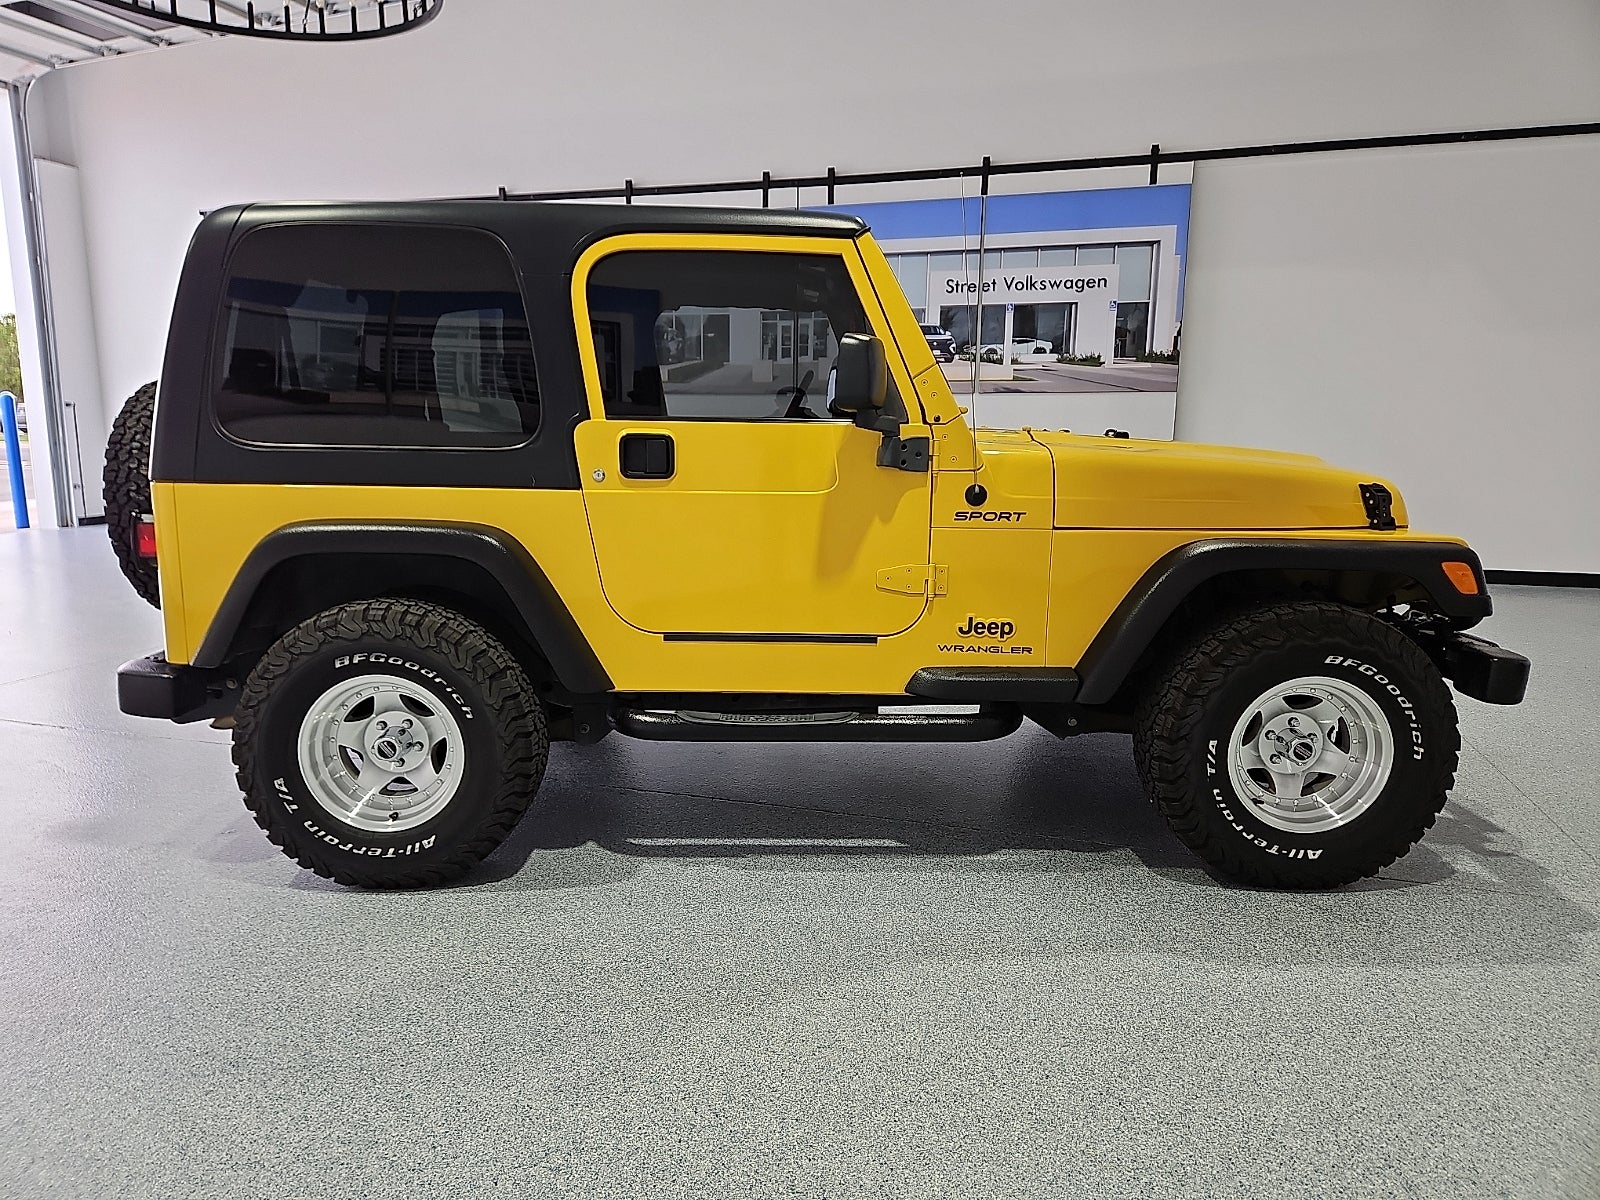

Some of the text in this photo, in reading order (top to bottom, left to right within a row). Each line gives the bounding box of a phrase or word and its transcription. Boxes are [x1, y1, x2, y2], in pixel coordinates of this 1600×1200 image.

[945, 275, 1108, 294] Street Volkswagen
[953, 511, 1027, 522] SPORT
[938, 644, 1033, 655] WRANGLER
[957, 615, 1015, 640] Jeep
[334, 652, 475, 720] BFGoodrich
[1323, 655, 1425, 761] BFGoodrich
[273, 776, 437, 859] All-Terrain T/A
[1206, 739, 1324, 860] All-Terrain T/A
